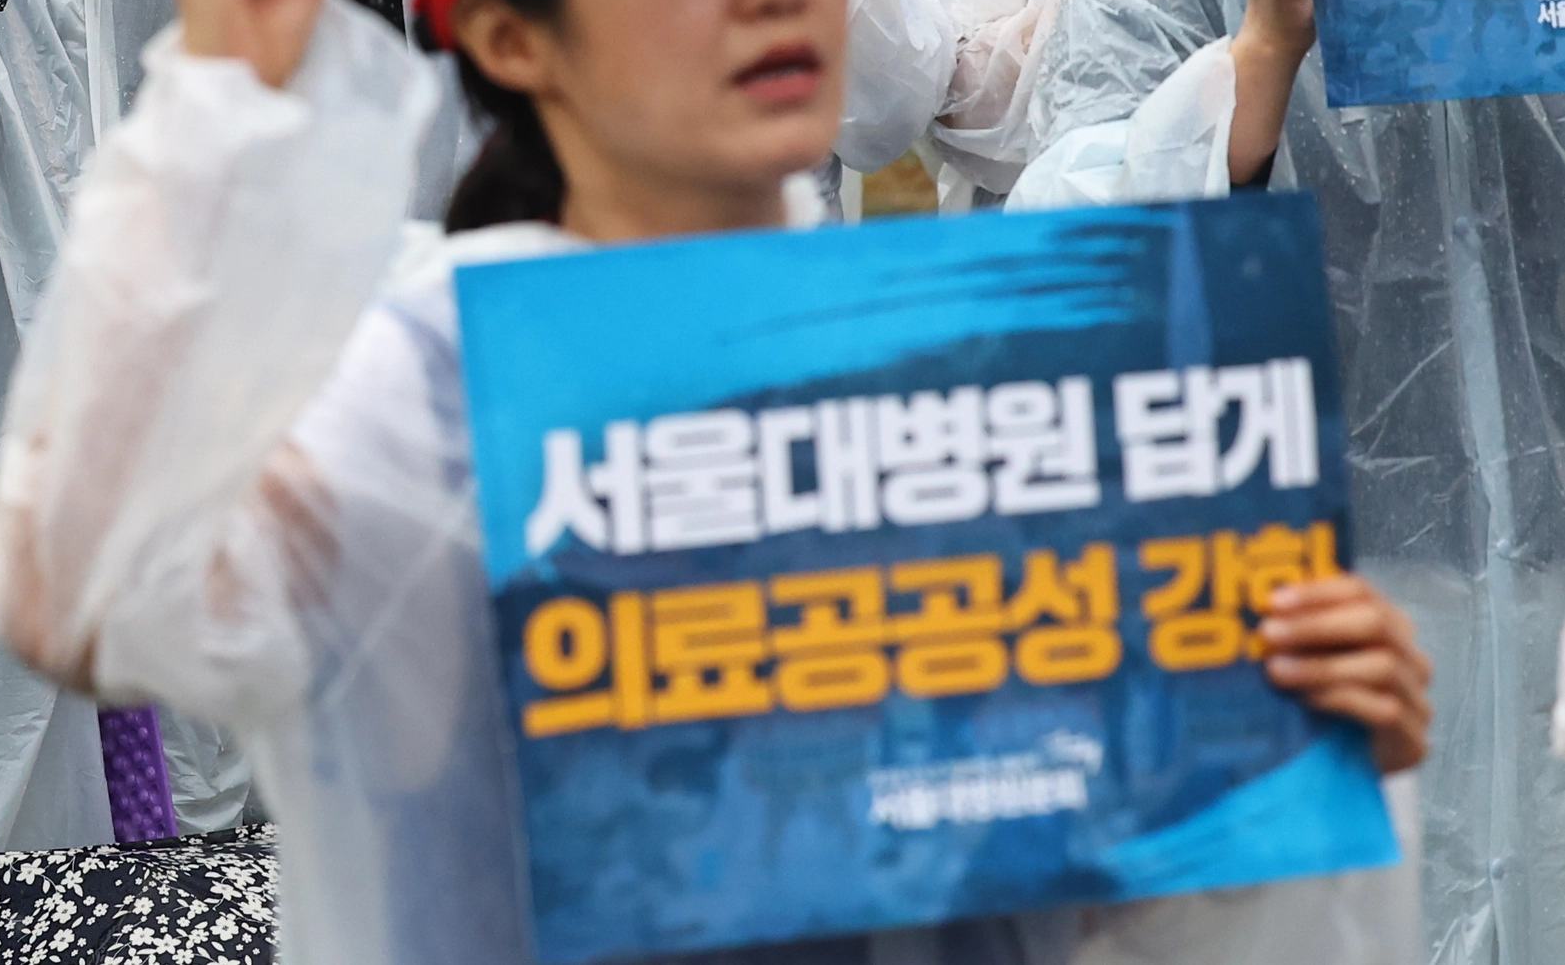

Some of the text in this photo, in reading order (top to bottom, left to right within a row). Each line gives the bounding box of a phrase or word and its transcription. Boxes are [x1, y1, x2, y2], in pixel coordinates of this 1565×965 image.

[525, 358, 1320, 557] 서울대병원 답게
[521, 542, 1123, 739] 의료공공성
